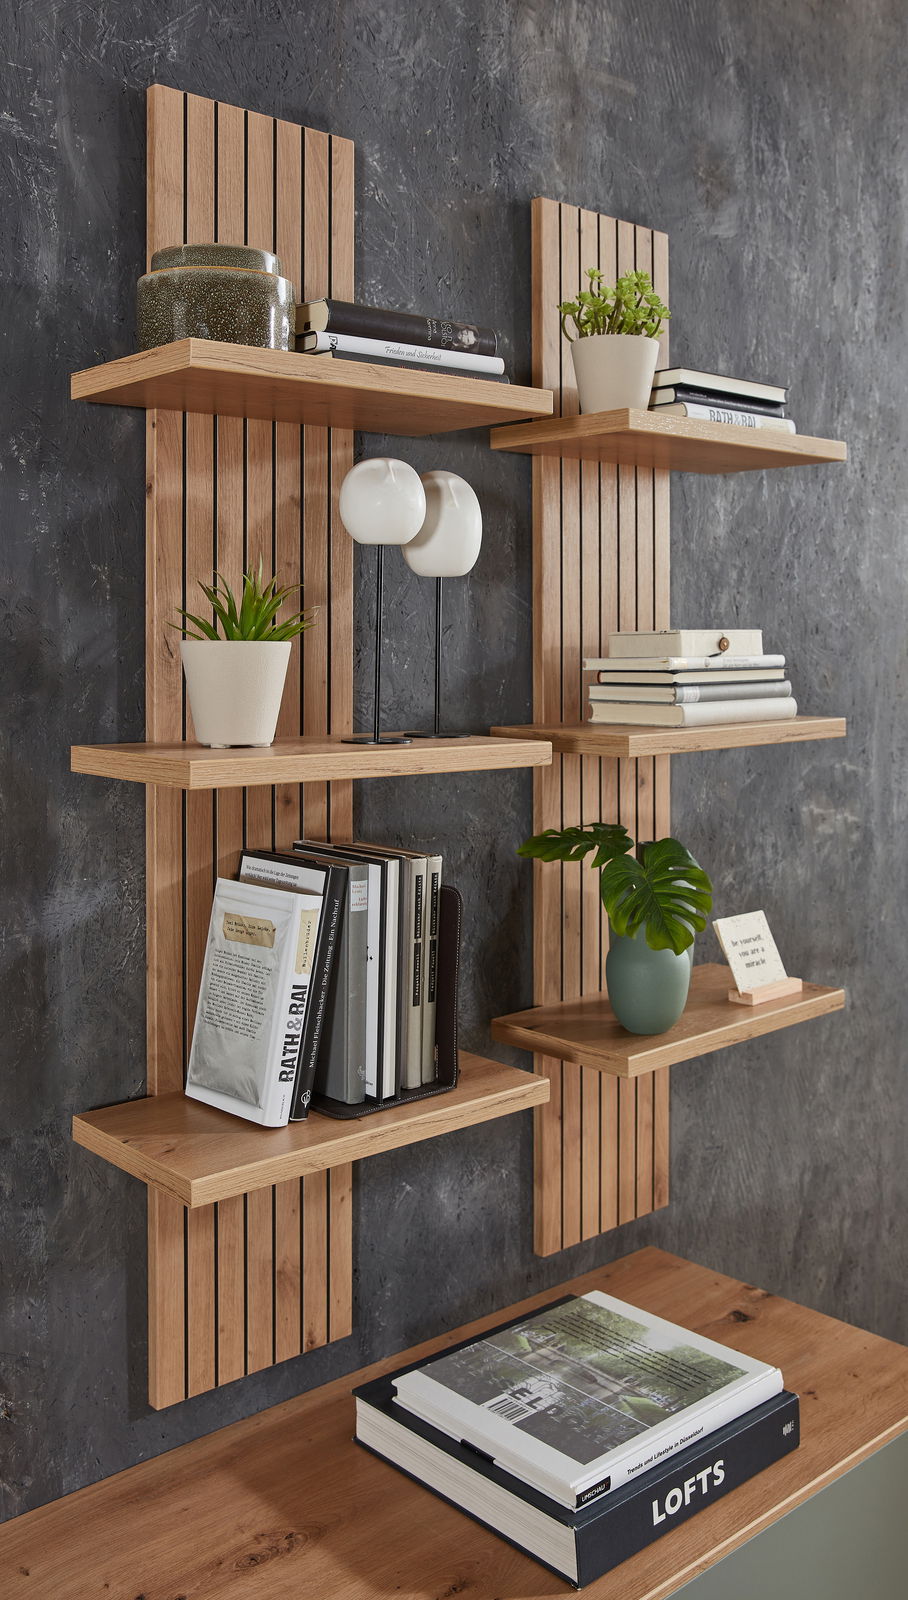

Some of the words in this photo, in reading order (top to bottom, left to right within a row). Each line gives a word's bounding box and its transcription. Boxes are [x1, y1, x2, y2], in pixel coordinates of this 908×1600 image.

[384, 345, 406, 357] Frieden
[406, 350, 416, 358] und
[416, 350, 442, 362] Sicherheit
[314, 990, 326, 1039] Fleischhacker
[325, 945, 334, 974] Zeitung
[330, 899, 340, 928] Nachruf
[288, 984, 308, 1015] RAI
[287, 1018, 302, 1031] &
[278, 1034, 301, 1082] RATH
[627, 1462, 644, 1475] Trends
[644, 1457, 654, 1468] und
[654, 1444, 674, 1462] Lifestyle
[679, 1426, 704, 1446] Düsseldorf
[652, 1459, 726, 1526] LOFTS
